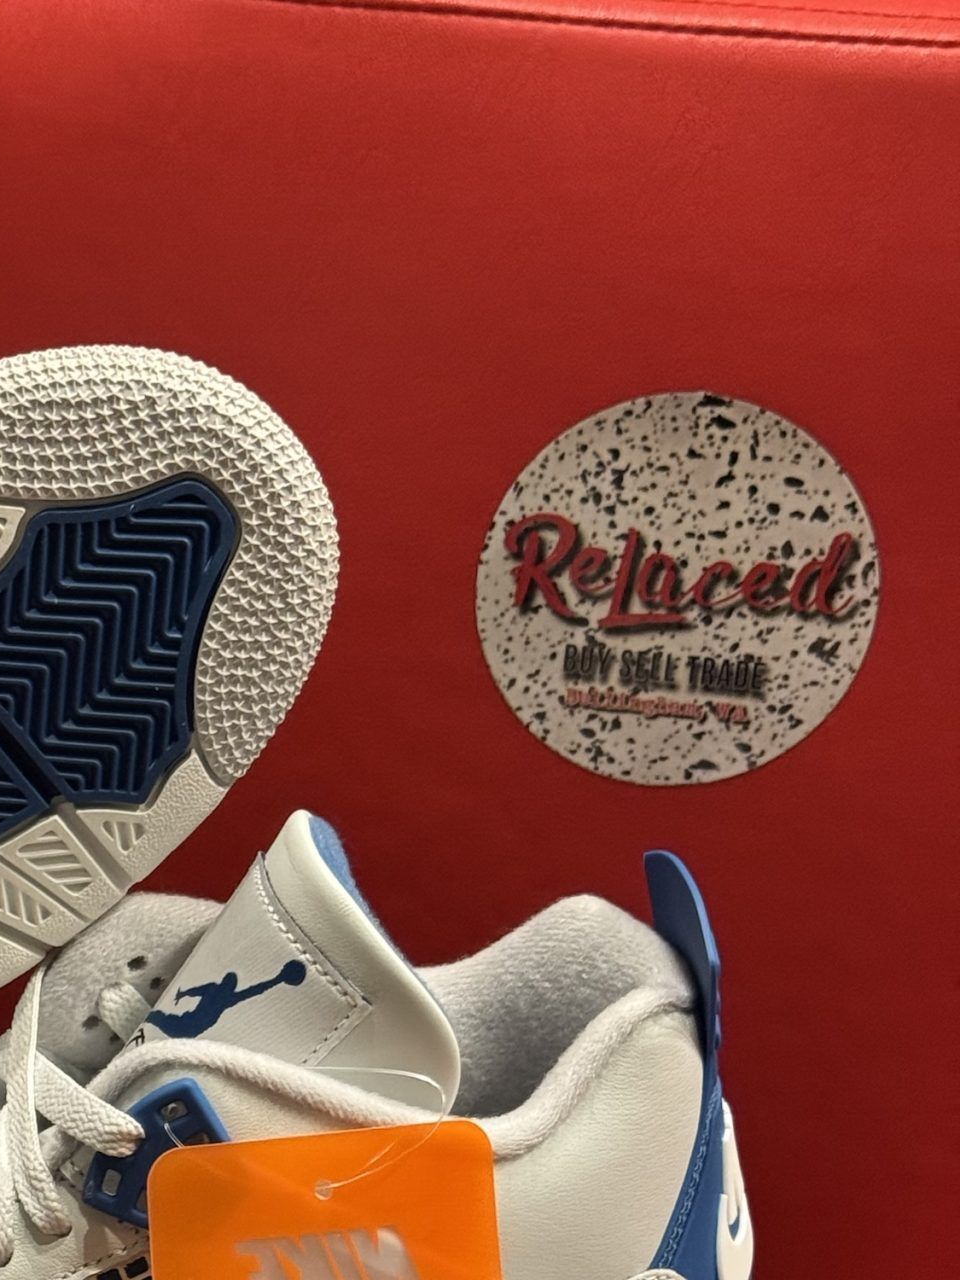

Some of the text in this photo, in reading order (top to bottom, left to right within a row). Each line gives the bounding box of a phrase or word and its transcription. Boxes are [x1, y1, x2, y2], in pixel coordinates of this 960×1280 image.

[563, 644, 768, 690] BUY SELL TRADE
